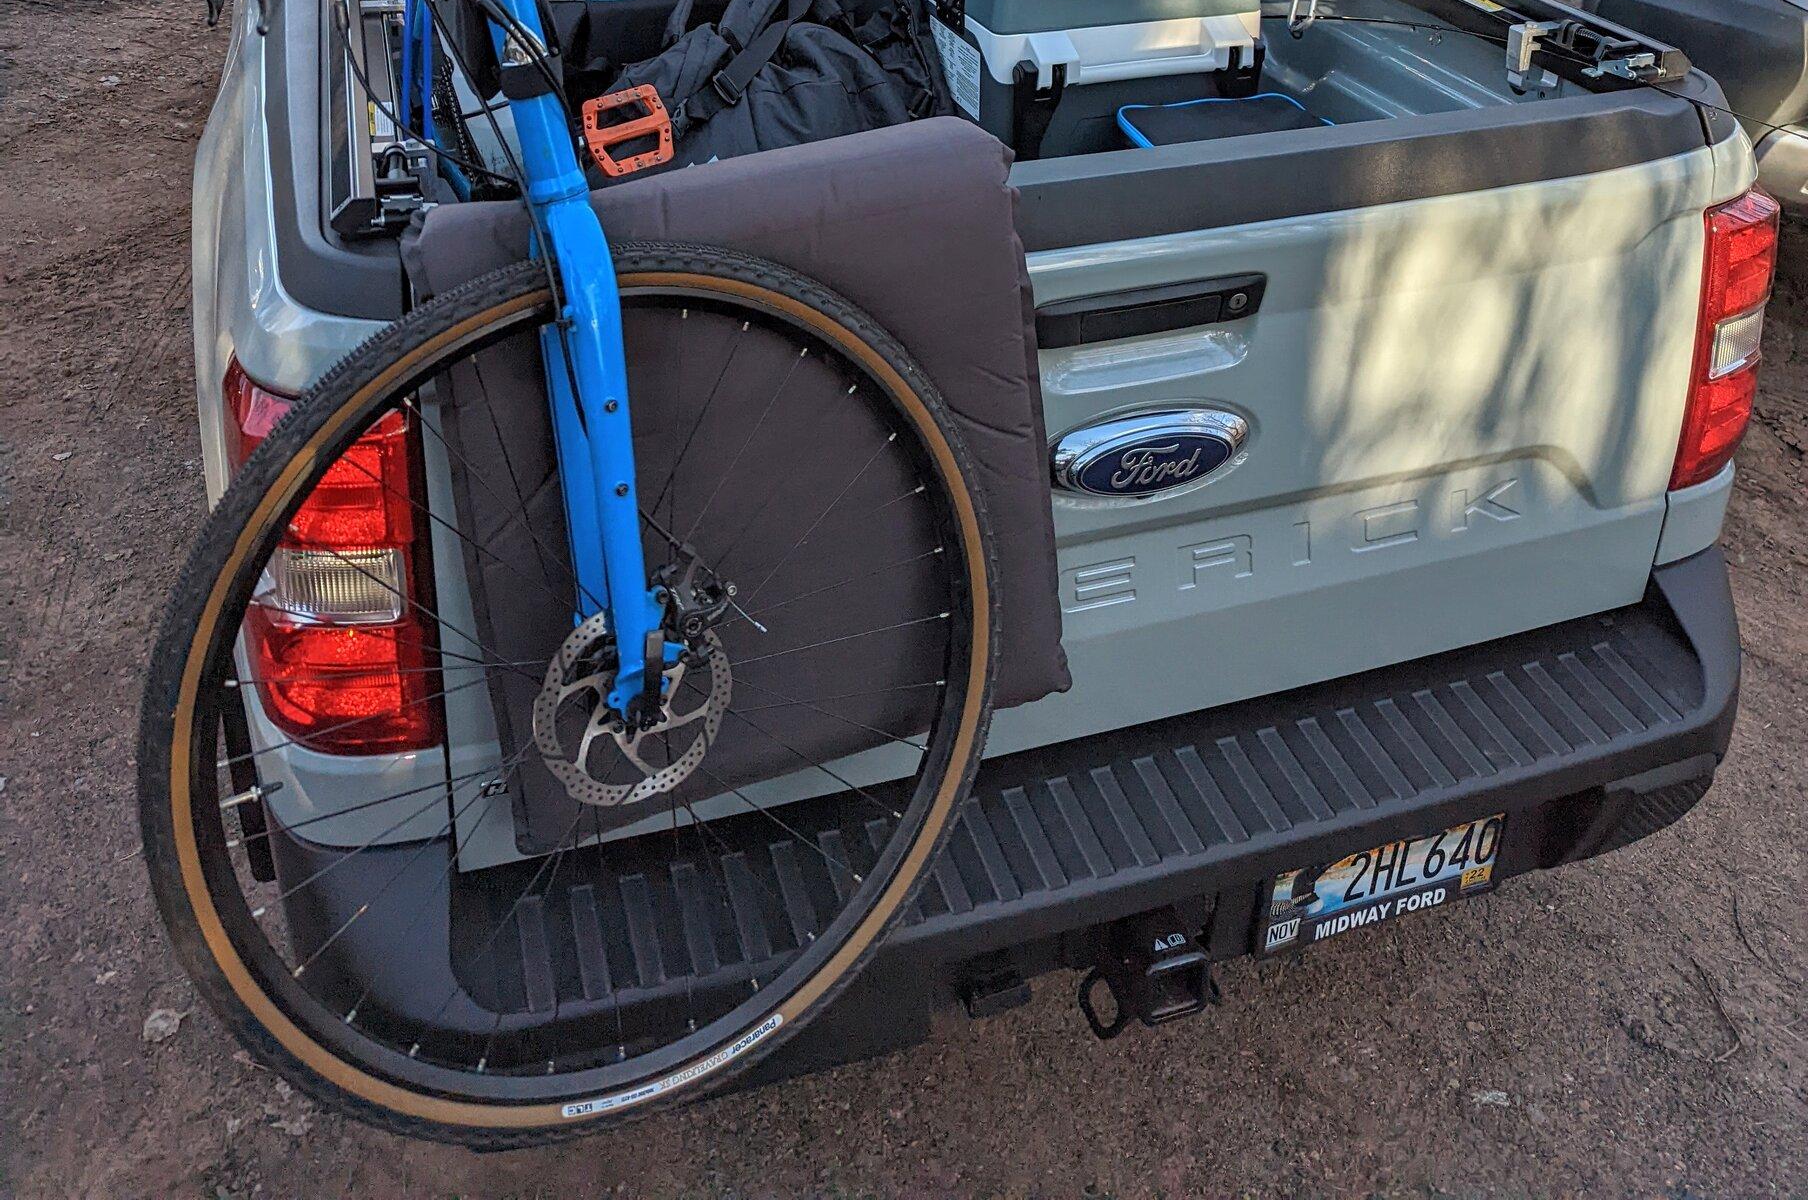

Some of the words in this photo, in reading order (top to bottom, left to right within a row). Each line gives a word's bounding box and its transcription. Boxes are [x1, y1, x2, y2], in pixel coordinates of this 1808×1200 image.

[1110, 443, 1202, 490] Ford
[1268, 921, 1299, 944] NOV
[1314, 901, 1392, 940] MIDWAY
[1395, 887, 1446, 916] FORD
[731, 1018, 777, 1055] Panaracer
